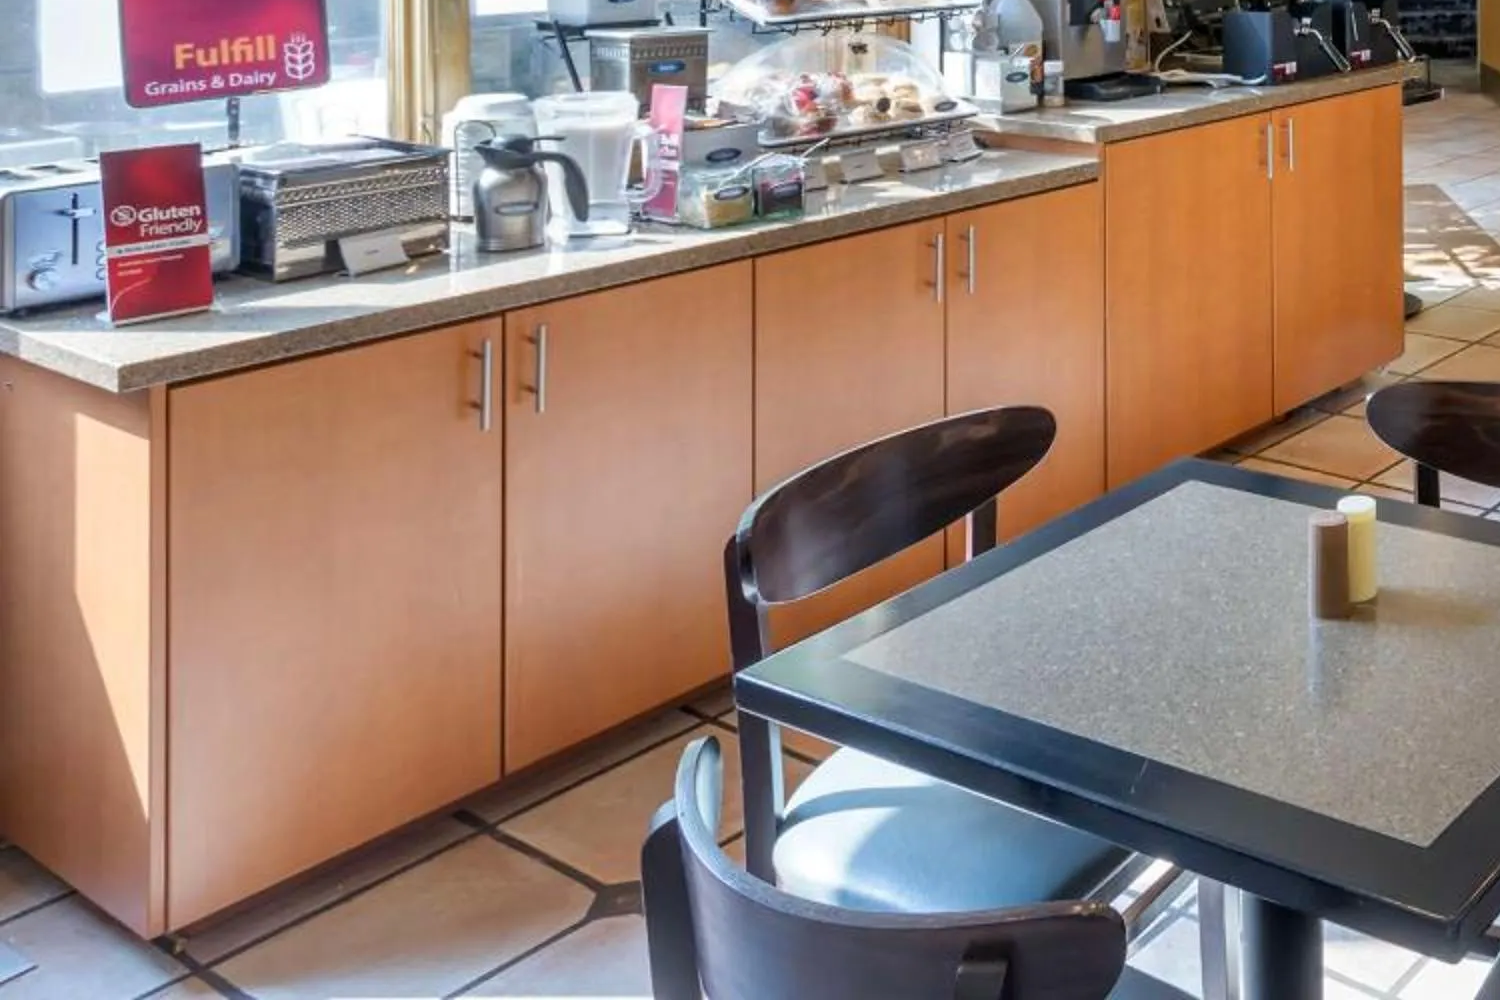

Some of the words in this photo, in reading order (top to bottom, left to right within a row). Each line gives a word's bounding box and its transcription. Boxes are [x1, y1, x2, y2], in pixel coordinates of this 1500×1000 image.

[174, 35, 277, 69] Fulfill
[144, 78, 207, 96] Grains
[210, 76, 225, 89] &
[229, 71, 277, 87] Dairy
[138, 205, 201, 222] Gluten
[140, 218, 203, 238] Friendly
